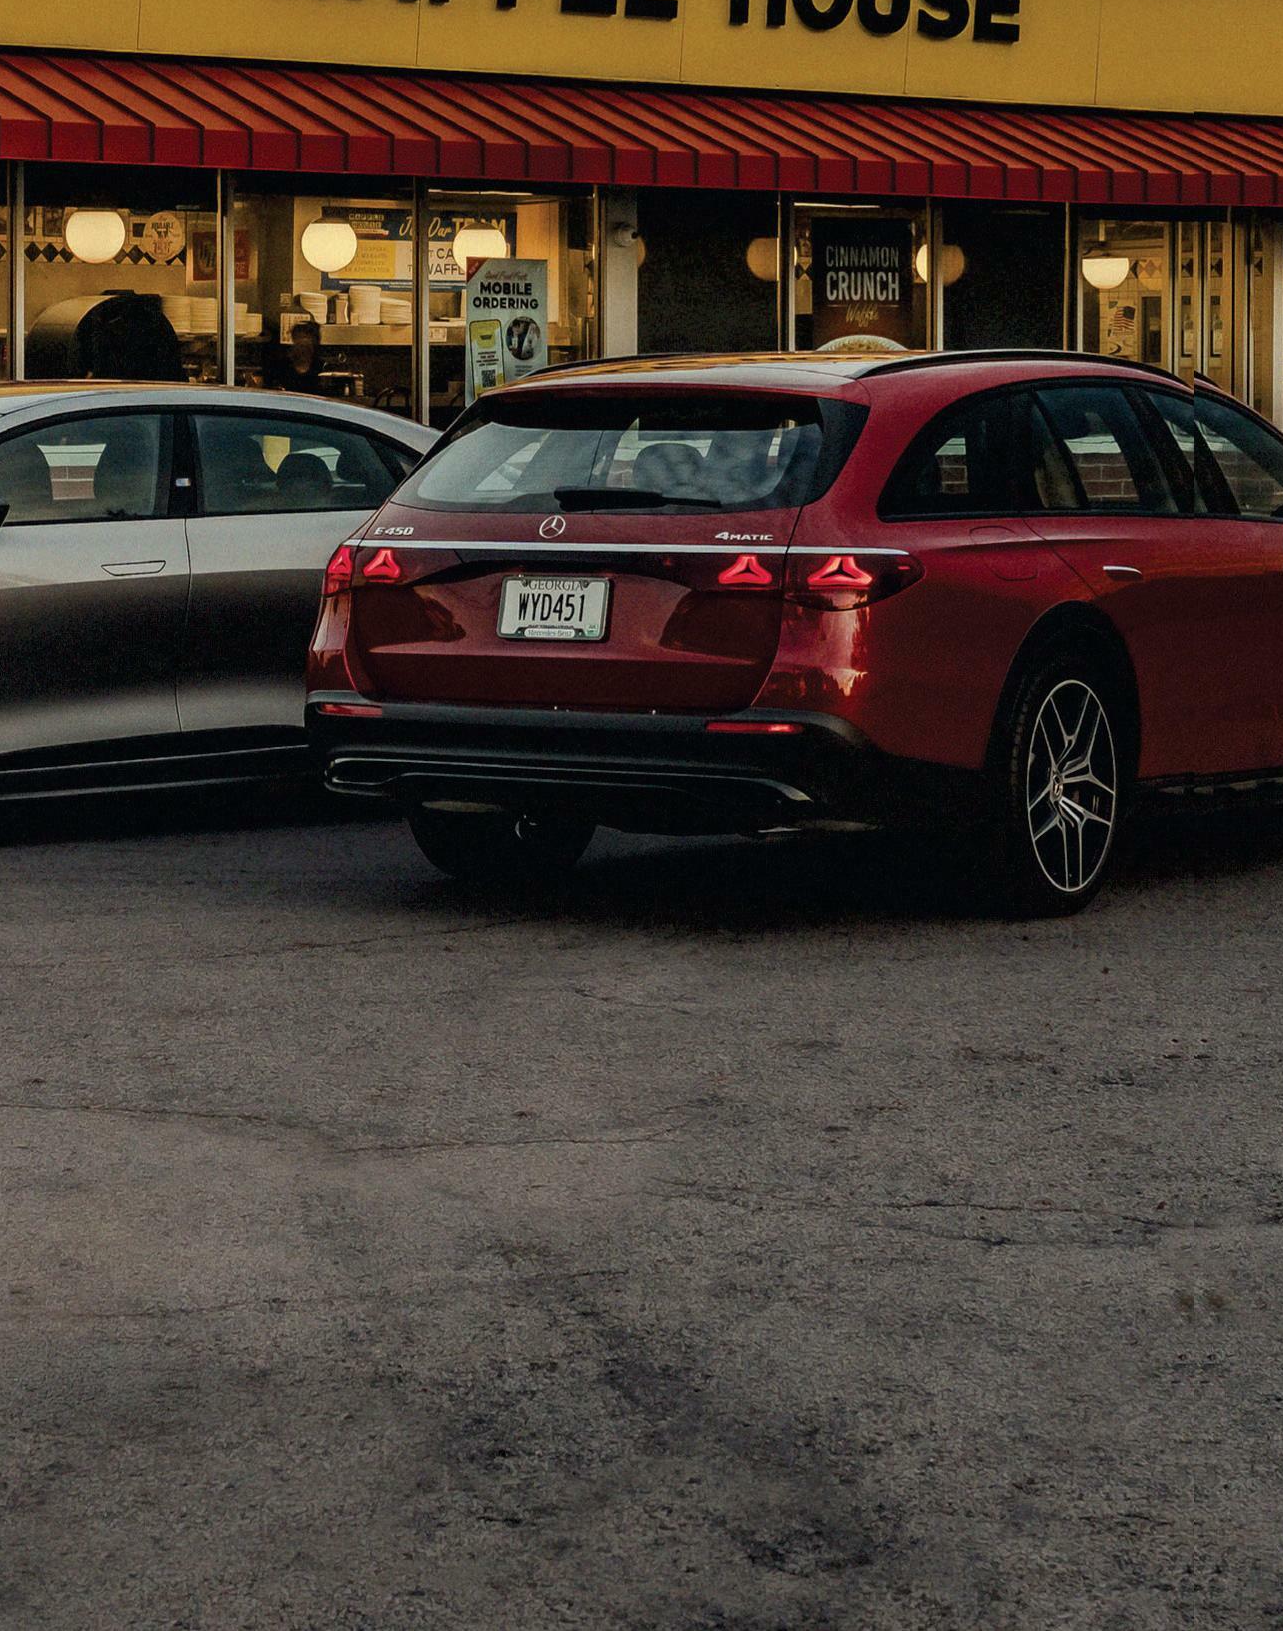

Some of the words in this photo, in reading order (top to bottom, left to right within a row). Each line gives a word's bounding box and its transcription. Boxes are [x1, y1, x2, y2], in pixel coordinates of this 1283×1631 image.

[825, 245, 899, 268] CINNAMON
[480, 282, 532, 296] MOBILE
[826, 271, 899, 301] CRUNCH
[473, 297, 539, 309] ORDERING
[846, 304, 878, 328] Waffle
[374, 527, 385, 536] E
[385, 527, 414, 536] 450
[715, 531, 774, 541] 4MATIC
[528, 580, 584, 591] GEORGIA
[518, 593, 585, 622] WYD451
